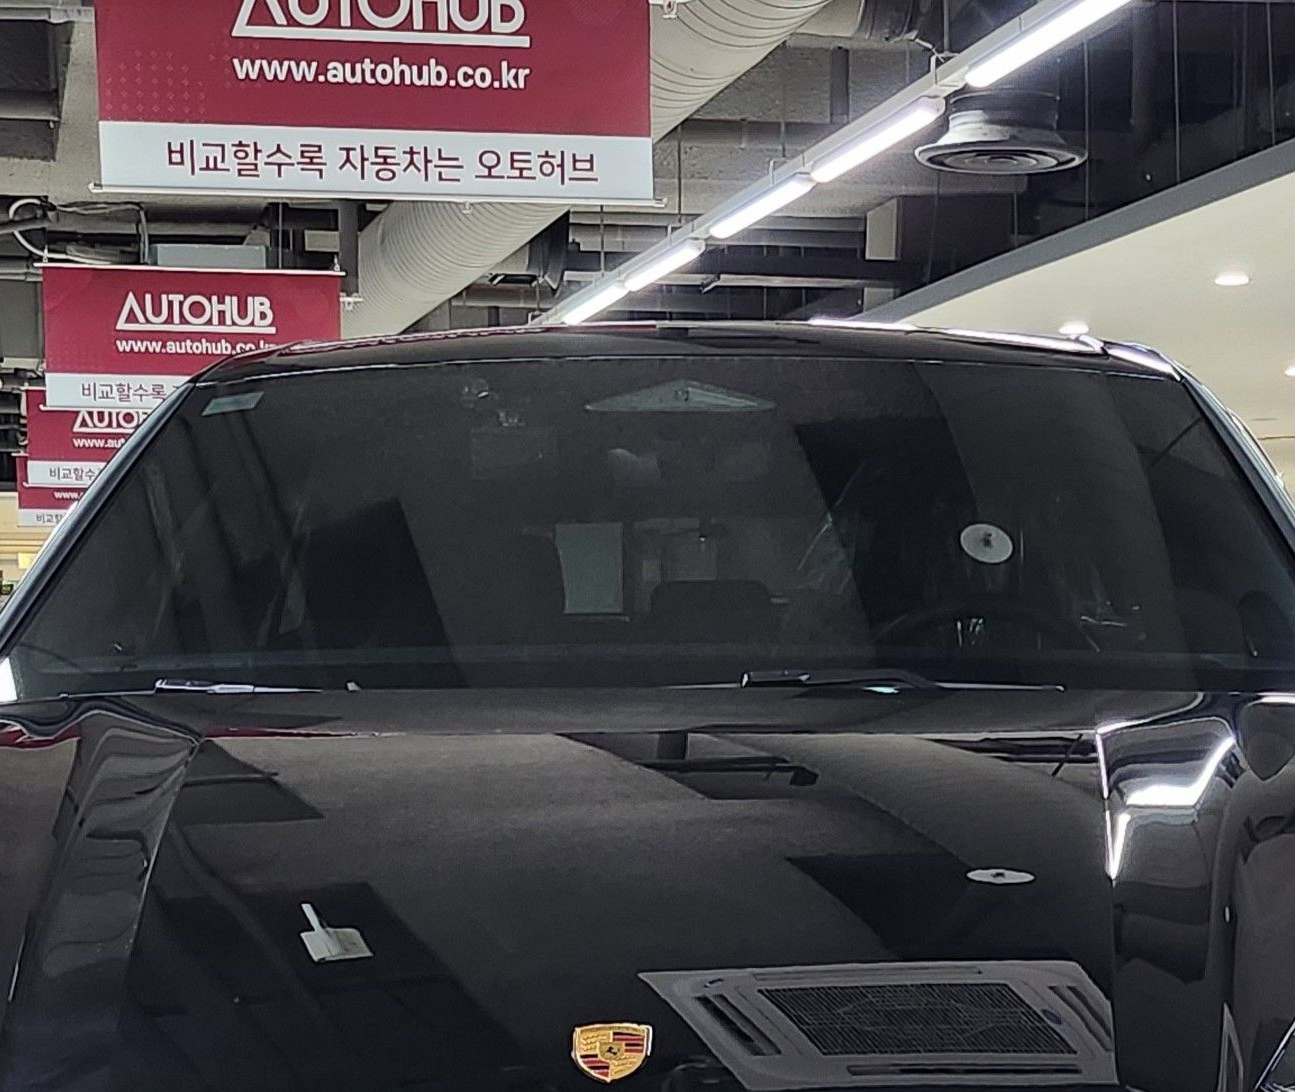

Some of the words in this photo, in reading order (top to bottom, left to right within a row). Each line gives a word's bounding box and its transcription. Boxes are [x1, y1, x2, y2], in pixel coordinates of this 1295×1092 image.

[231, 57, 531, 90] www.autohub.co.kr
[166, 138, 328, 180] 비교할수록
[337, 143, 466, 183] 자동차는
[474, 149, 599, 186] 오토허브
[115, 291, 277, 334] AUTOHUB
[81, 382, 167, 402] 비교할수록
[49, 467, 100, 481] 비교할수
